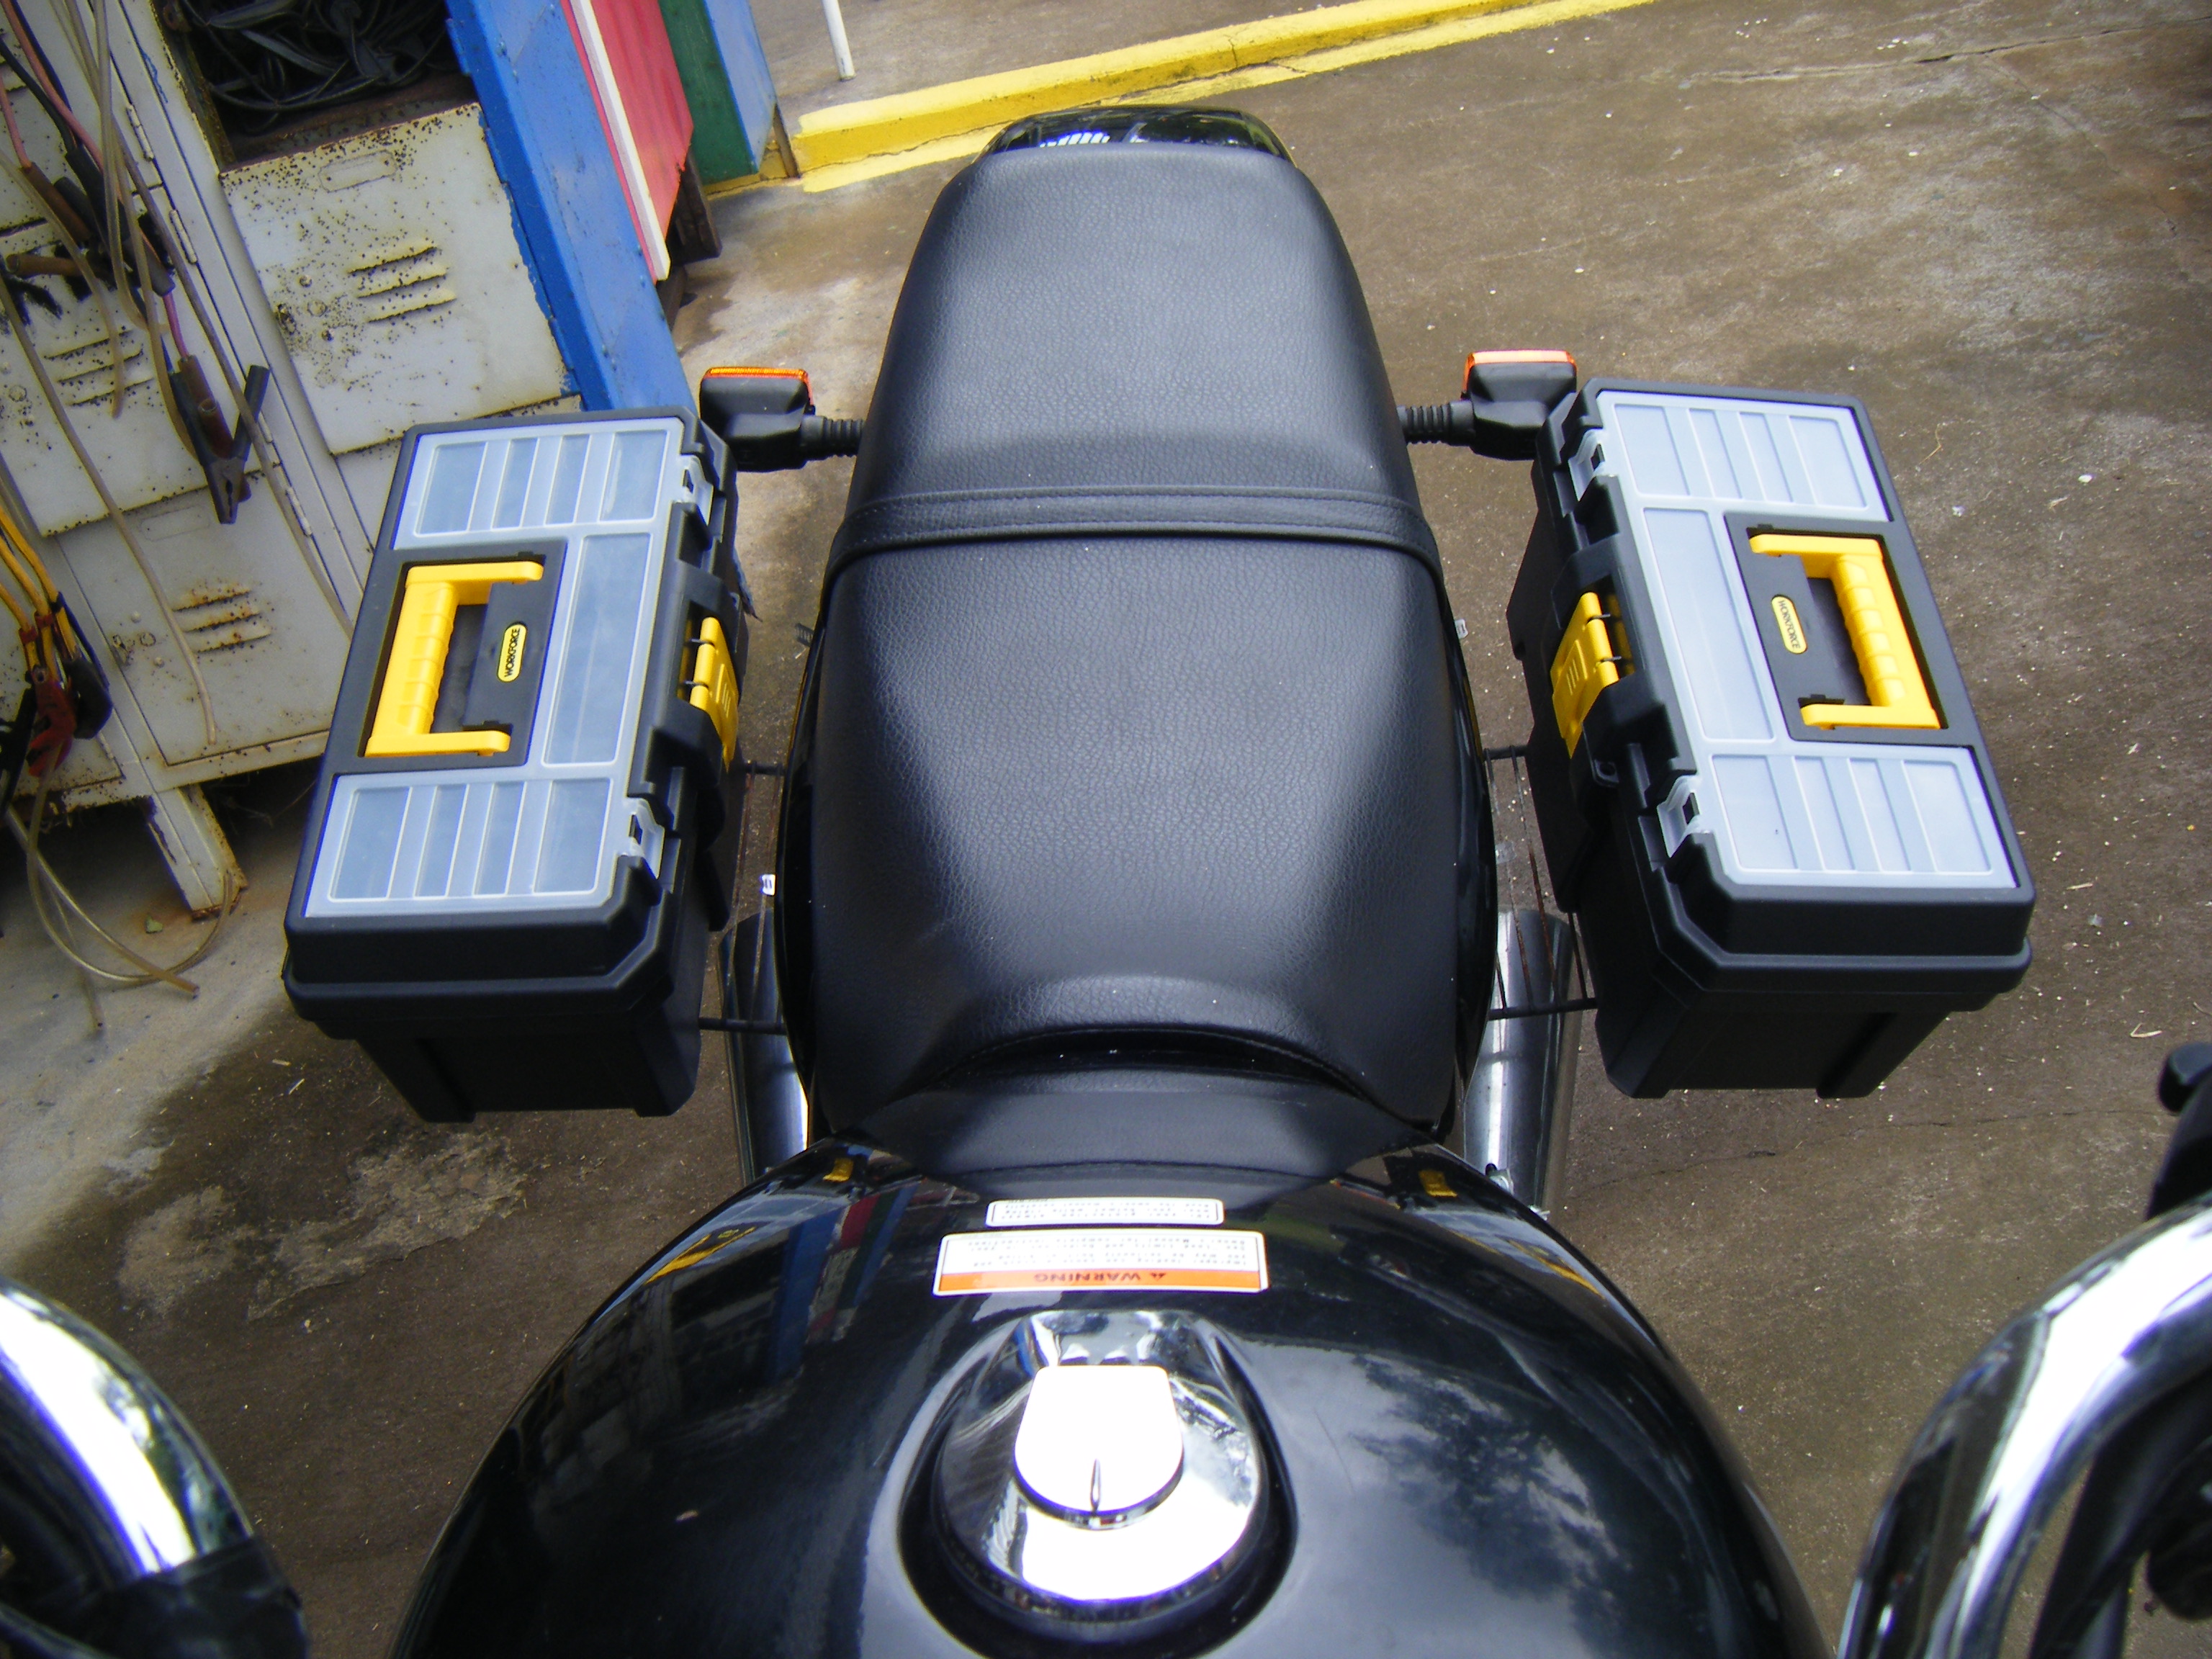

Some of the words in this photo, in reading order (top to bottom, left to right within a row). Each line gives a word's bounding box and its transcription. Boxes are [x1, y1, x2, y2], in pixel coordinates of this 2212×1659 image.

[1778, 600, 1801, 649] WORKFORCE
[504, 628, 520, 678] WORKFORCE
[1033, 1272, 1141, 1282] WARNING
